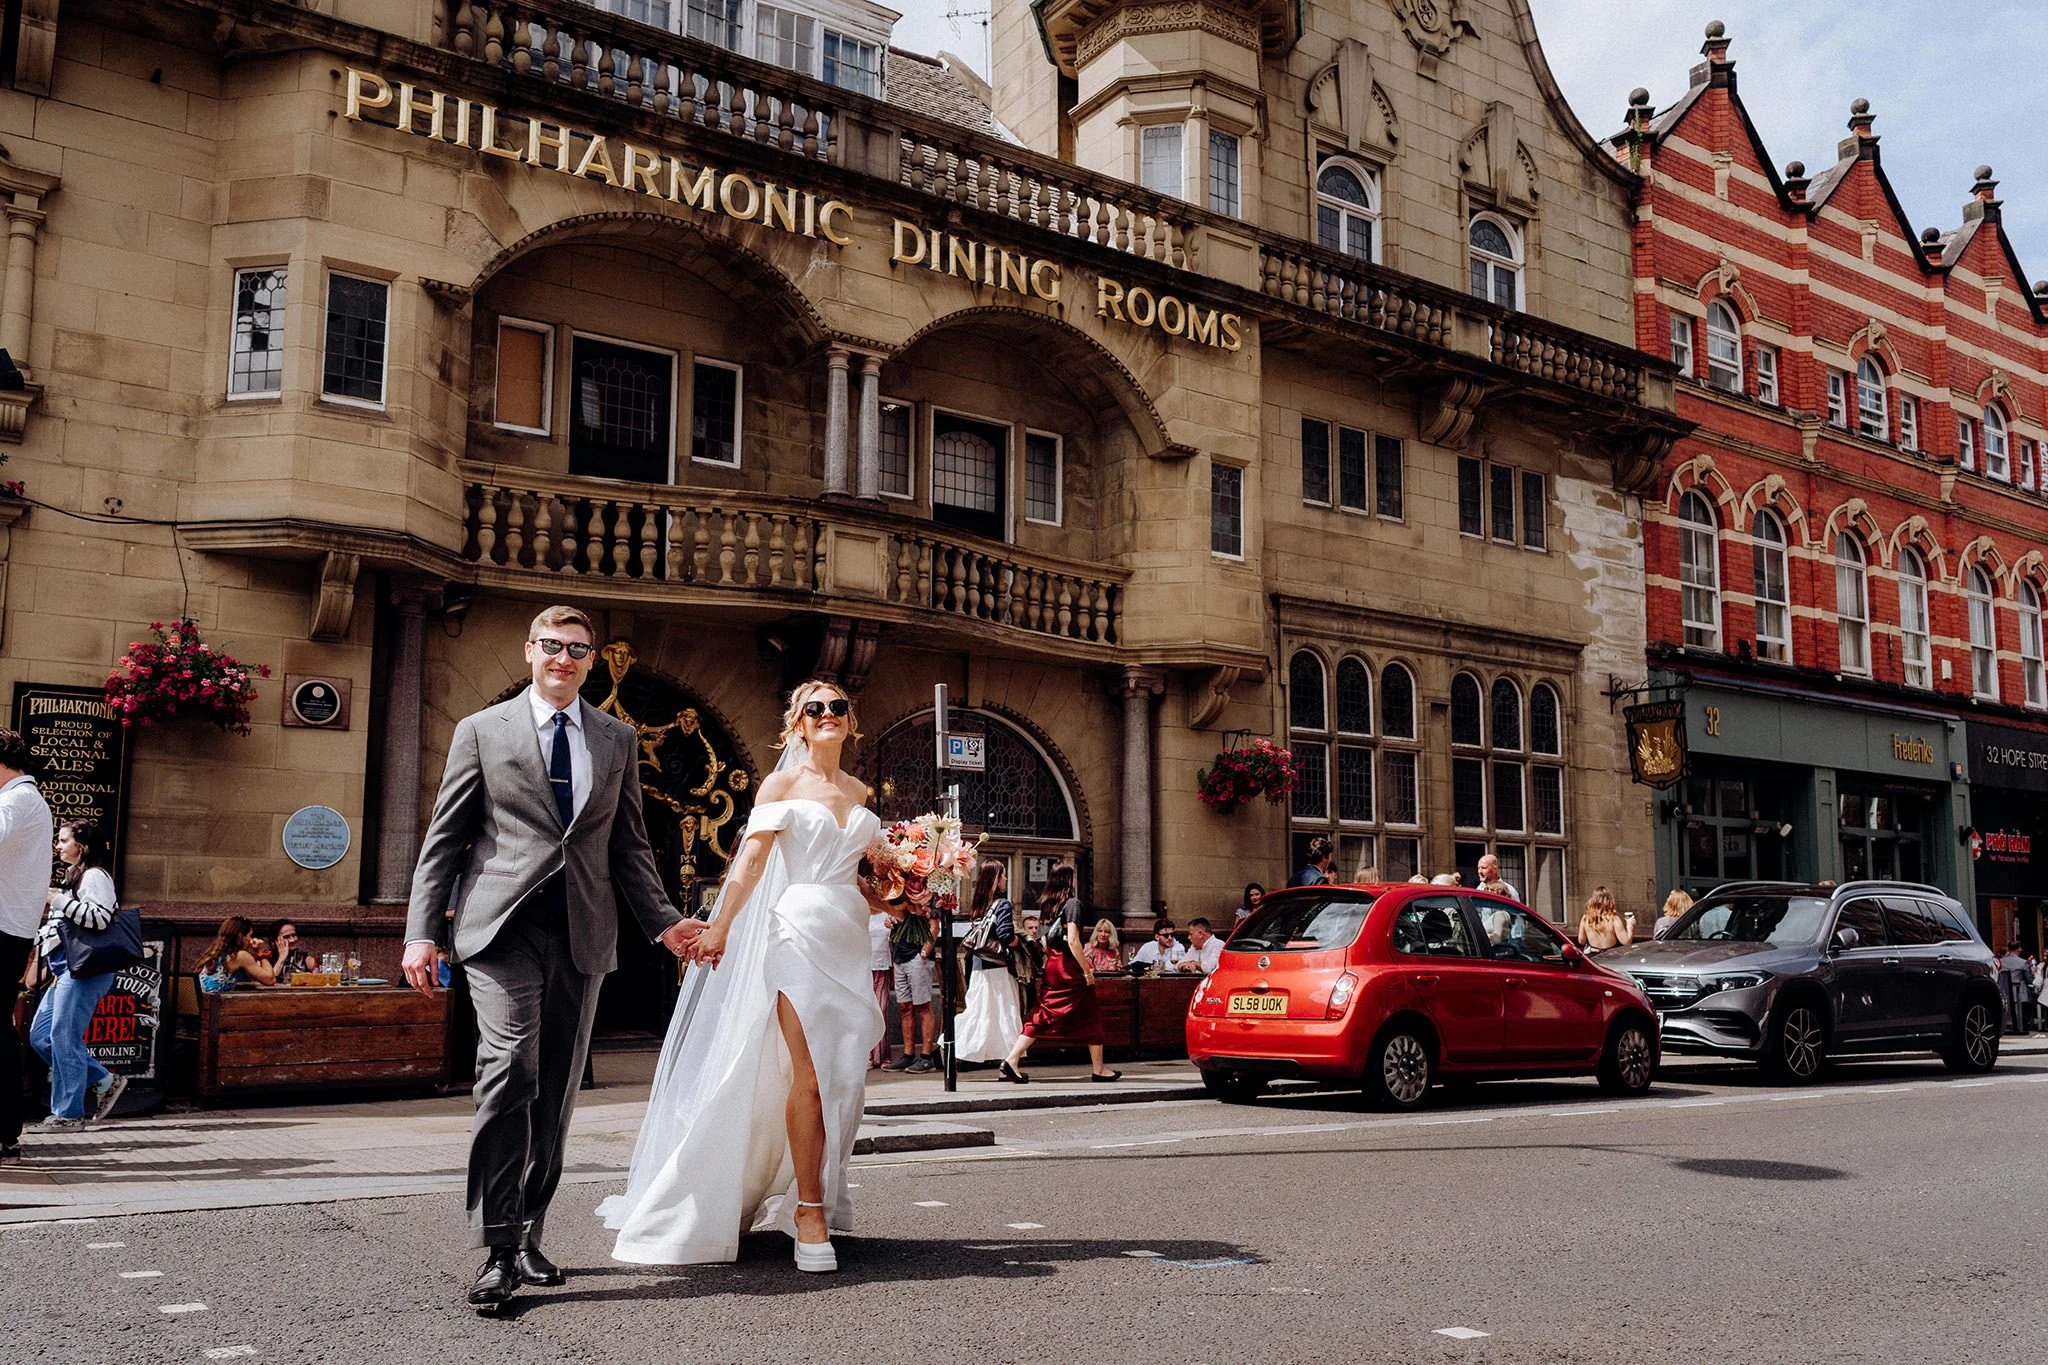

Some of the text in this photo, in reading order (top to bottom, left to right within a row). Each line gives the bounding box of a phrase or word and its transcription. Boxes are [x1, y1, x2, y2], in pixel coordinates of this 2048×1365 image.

[343, 66, 1242, 353] PHILHARMONIC DINING ROOMS
[29, 697, 117, 721] PHILHARMONIC
[54, 720, 92, 730] PROUD
[1706, 706, 1720, 735] 32
[31, 726, 113, 739] SELECTION OF
[39, 735, 104, 749] LOCAL &
[953, 741, 961, 752] P
[30, 745, 110, 760] SEASONAL
[1986, 745, 2048, 770] 32 HOPE STRE
[43, 757, 95, 772] ALES
[42, 790, 94, 806] FOOD
[116, 975, 151, 998] TOUR
[96, 995, 135, 1015] ARTS
[1233, 997, 1259, 1010] SL58
[1261, 998, 1282, 1011] UOK
[98, 1046, 136, 1057] ONLINE
